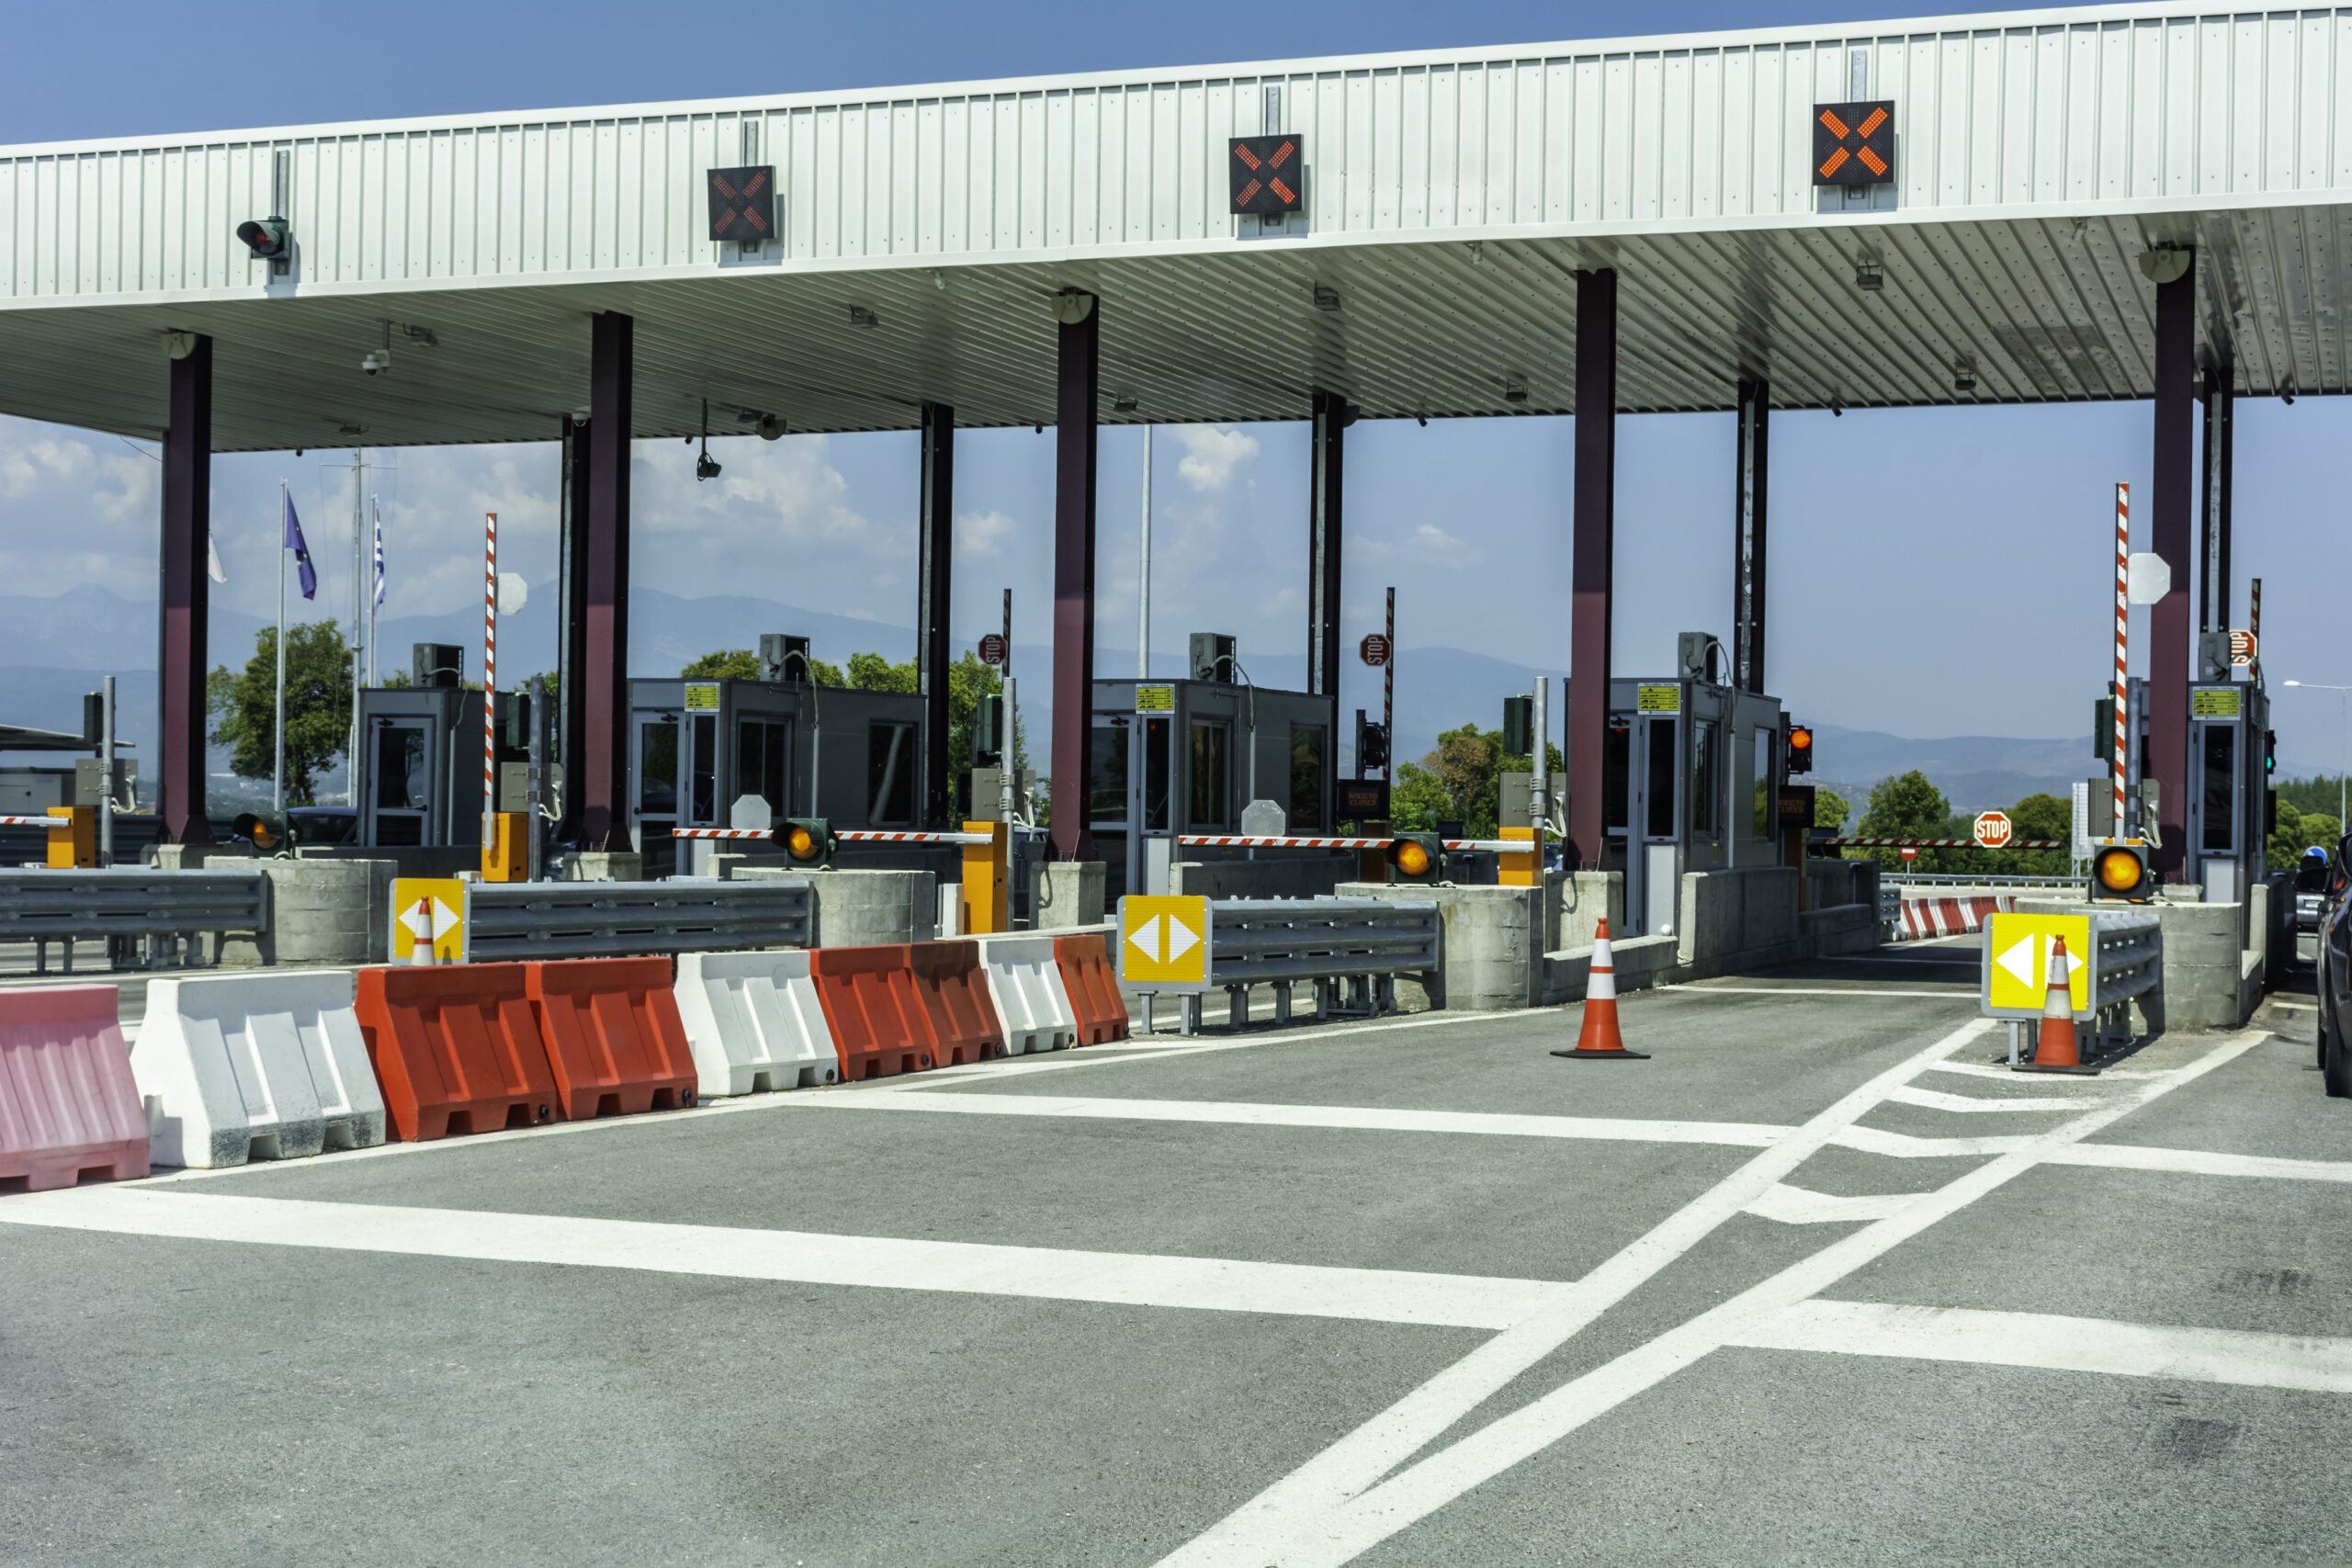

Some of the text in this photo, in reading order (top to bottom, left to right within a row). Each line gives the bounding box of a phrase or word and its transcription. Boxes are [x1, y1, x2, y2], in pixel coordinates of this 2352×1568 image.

[985, 637, 1001, 663] STOP
[1367, 637, 1384, 664] STOP
[1977, 820, 2008, 839] STOP
